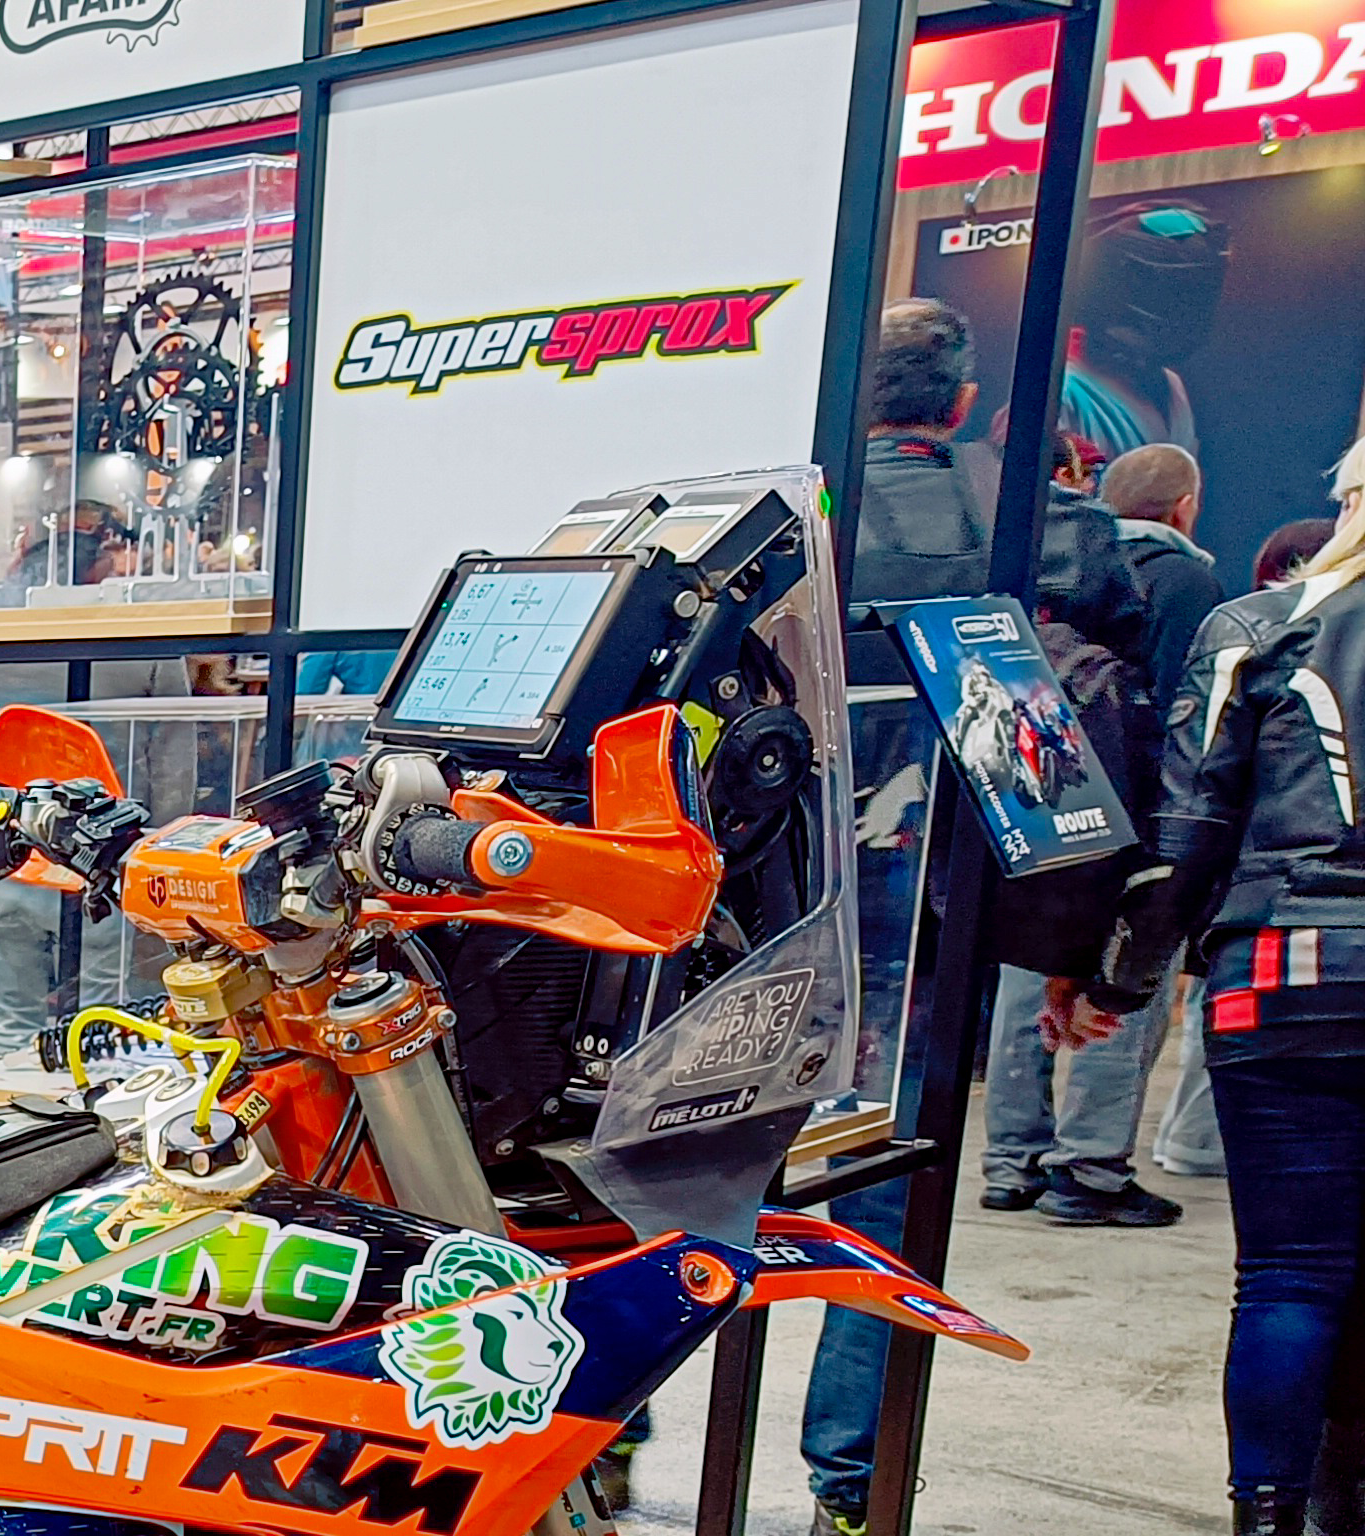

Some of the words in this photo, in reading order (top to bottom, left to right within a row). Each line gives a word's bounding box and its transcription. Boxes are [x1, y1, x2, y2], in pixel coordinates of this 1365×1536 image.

[440, 631, 472, 649] 13,74
[1052, 807, 1107, 836] ROUTE
[168, 878, 218, 900] DESIGN
[710, 991, 751, 1018] ARE
[756, 981, 804, 1008] YOU
[389, 1028, 435, 1061] ROCS
[688, 1032, 783, 1072] READY?
